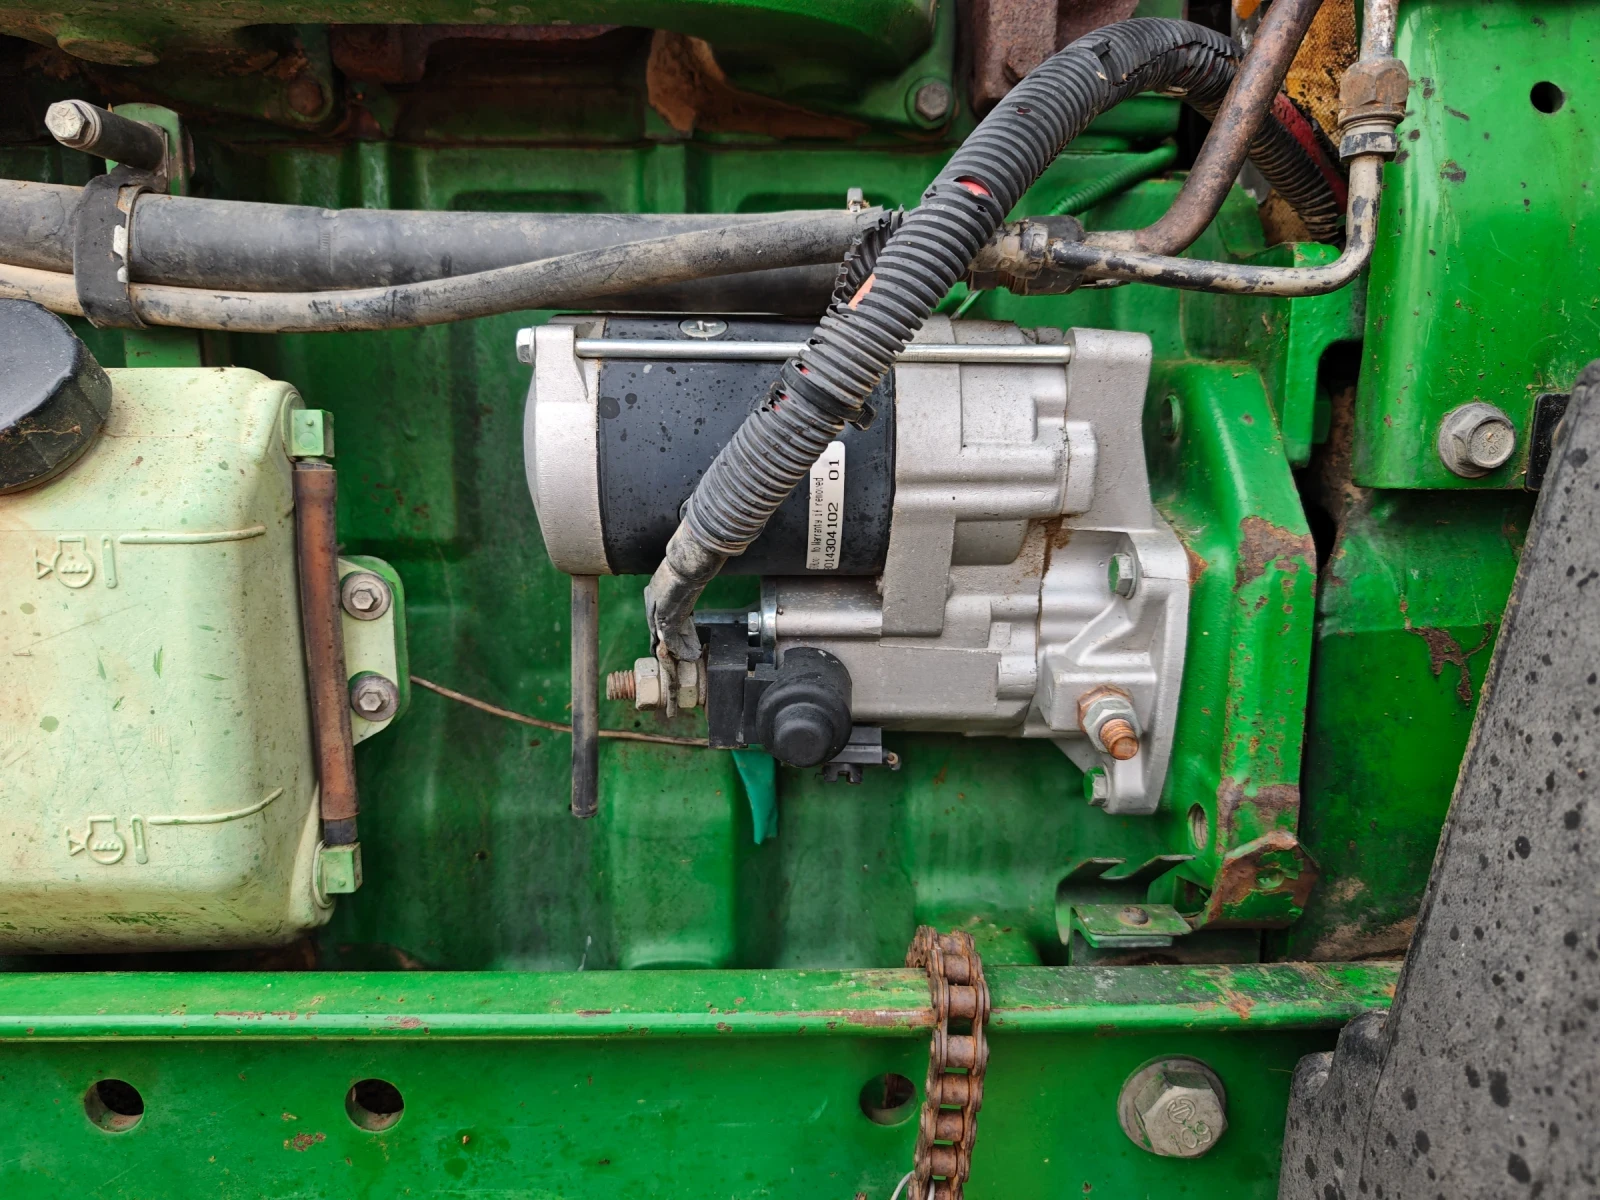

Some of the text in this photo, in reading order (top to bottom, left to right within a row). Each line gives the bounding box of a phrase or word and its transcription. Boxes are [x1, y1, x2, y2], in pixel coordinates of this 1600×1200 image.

[829, 459, 840, 481] 01
[813, 477, 823, 506] removed
[811, 519, 823, 546] Warranty
